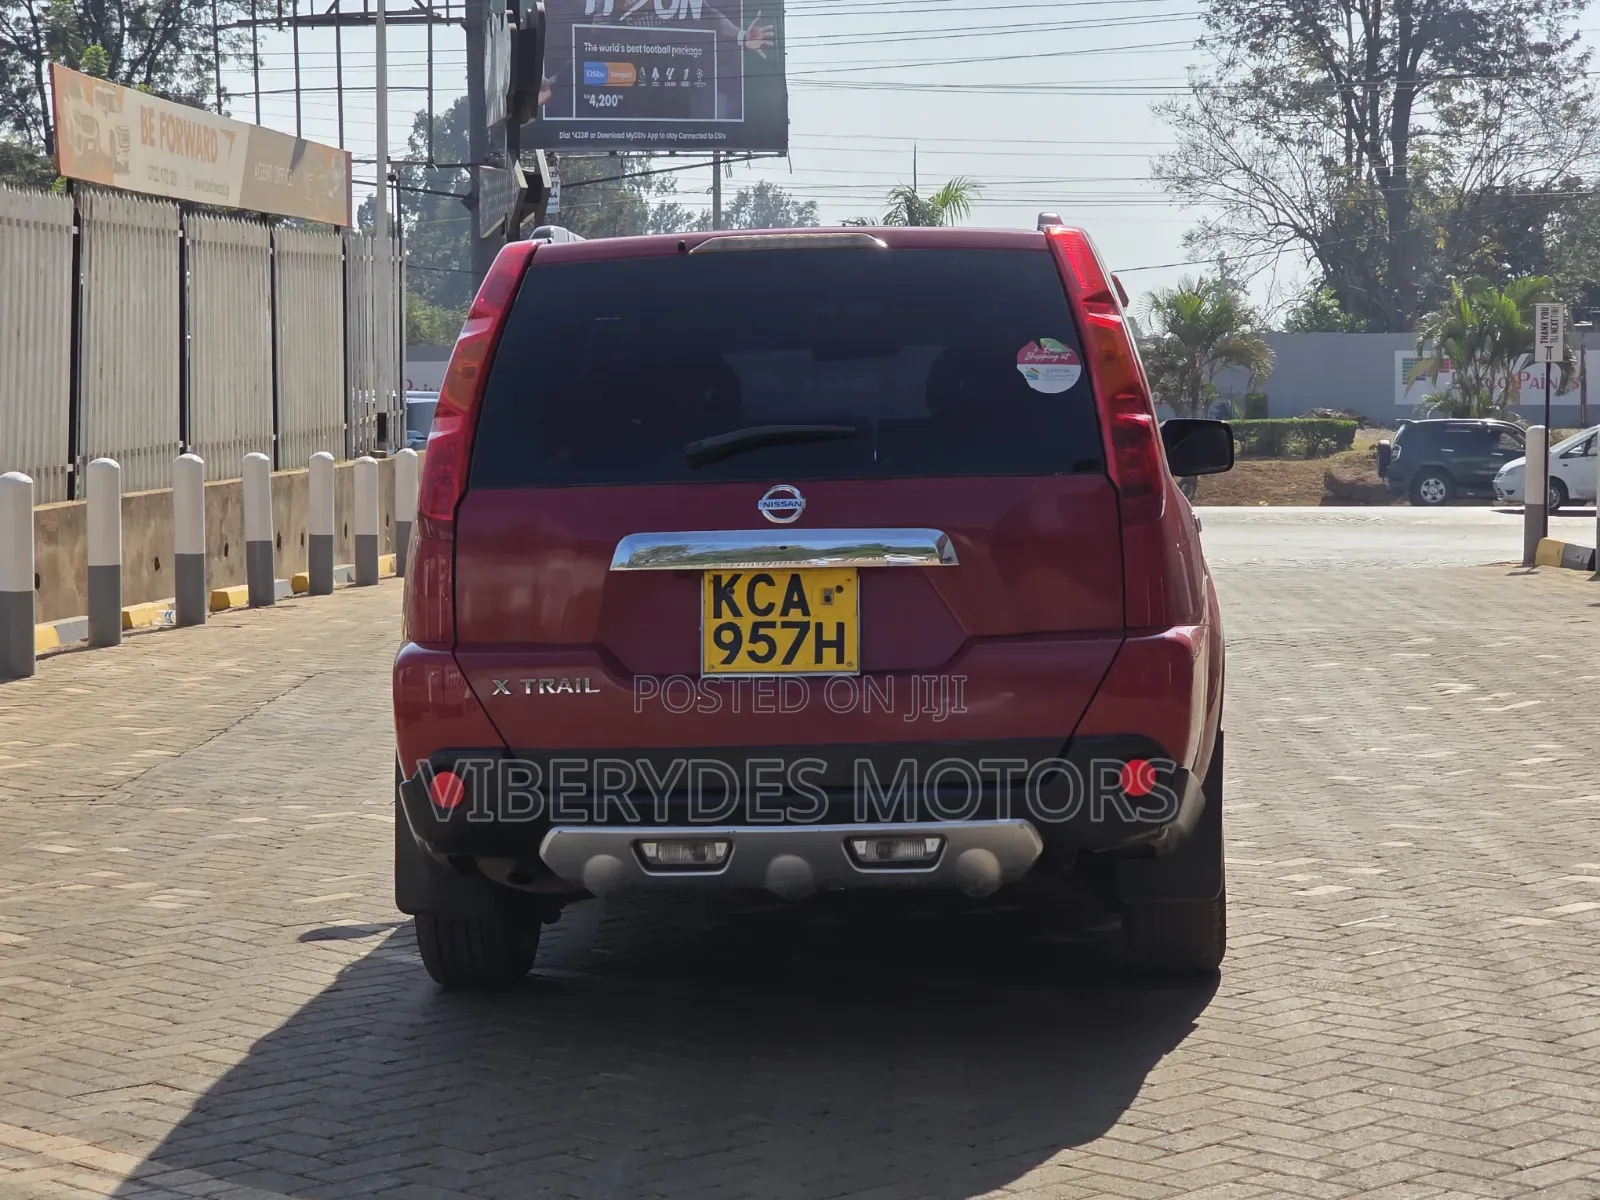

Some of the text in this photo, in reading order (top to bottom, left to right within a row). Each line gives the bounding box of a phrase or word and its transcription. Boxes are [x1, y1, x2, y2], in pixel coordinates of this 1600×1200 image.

[584, 42, 703, 58] The world's best football package
[586, 70, 633, 80] DStv Compact
[140, 104, 219, 164] BE FORWARD
[559, 131, 571, 139] Dial
[626, 132, 646, 141] MyDStv
[647, 132, 659, 141] App
[666, 132, 678, 141] stay
[708, 132, 714, 140] to
[714, 132, 727, 140] DStv
[1540, 306, 1550, 344] THANK YOU
[1550, 319, 1559, 335] NEXT
[1024, 351, 1060, 362] Shopping
[712, 573, 811, 619] KCA
[713, 620, 845, 665] 957H
[491, 677, 600, 696] X TRAIL
